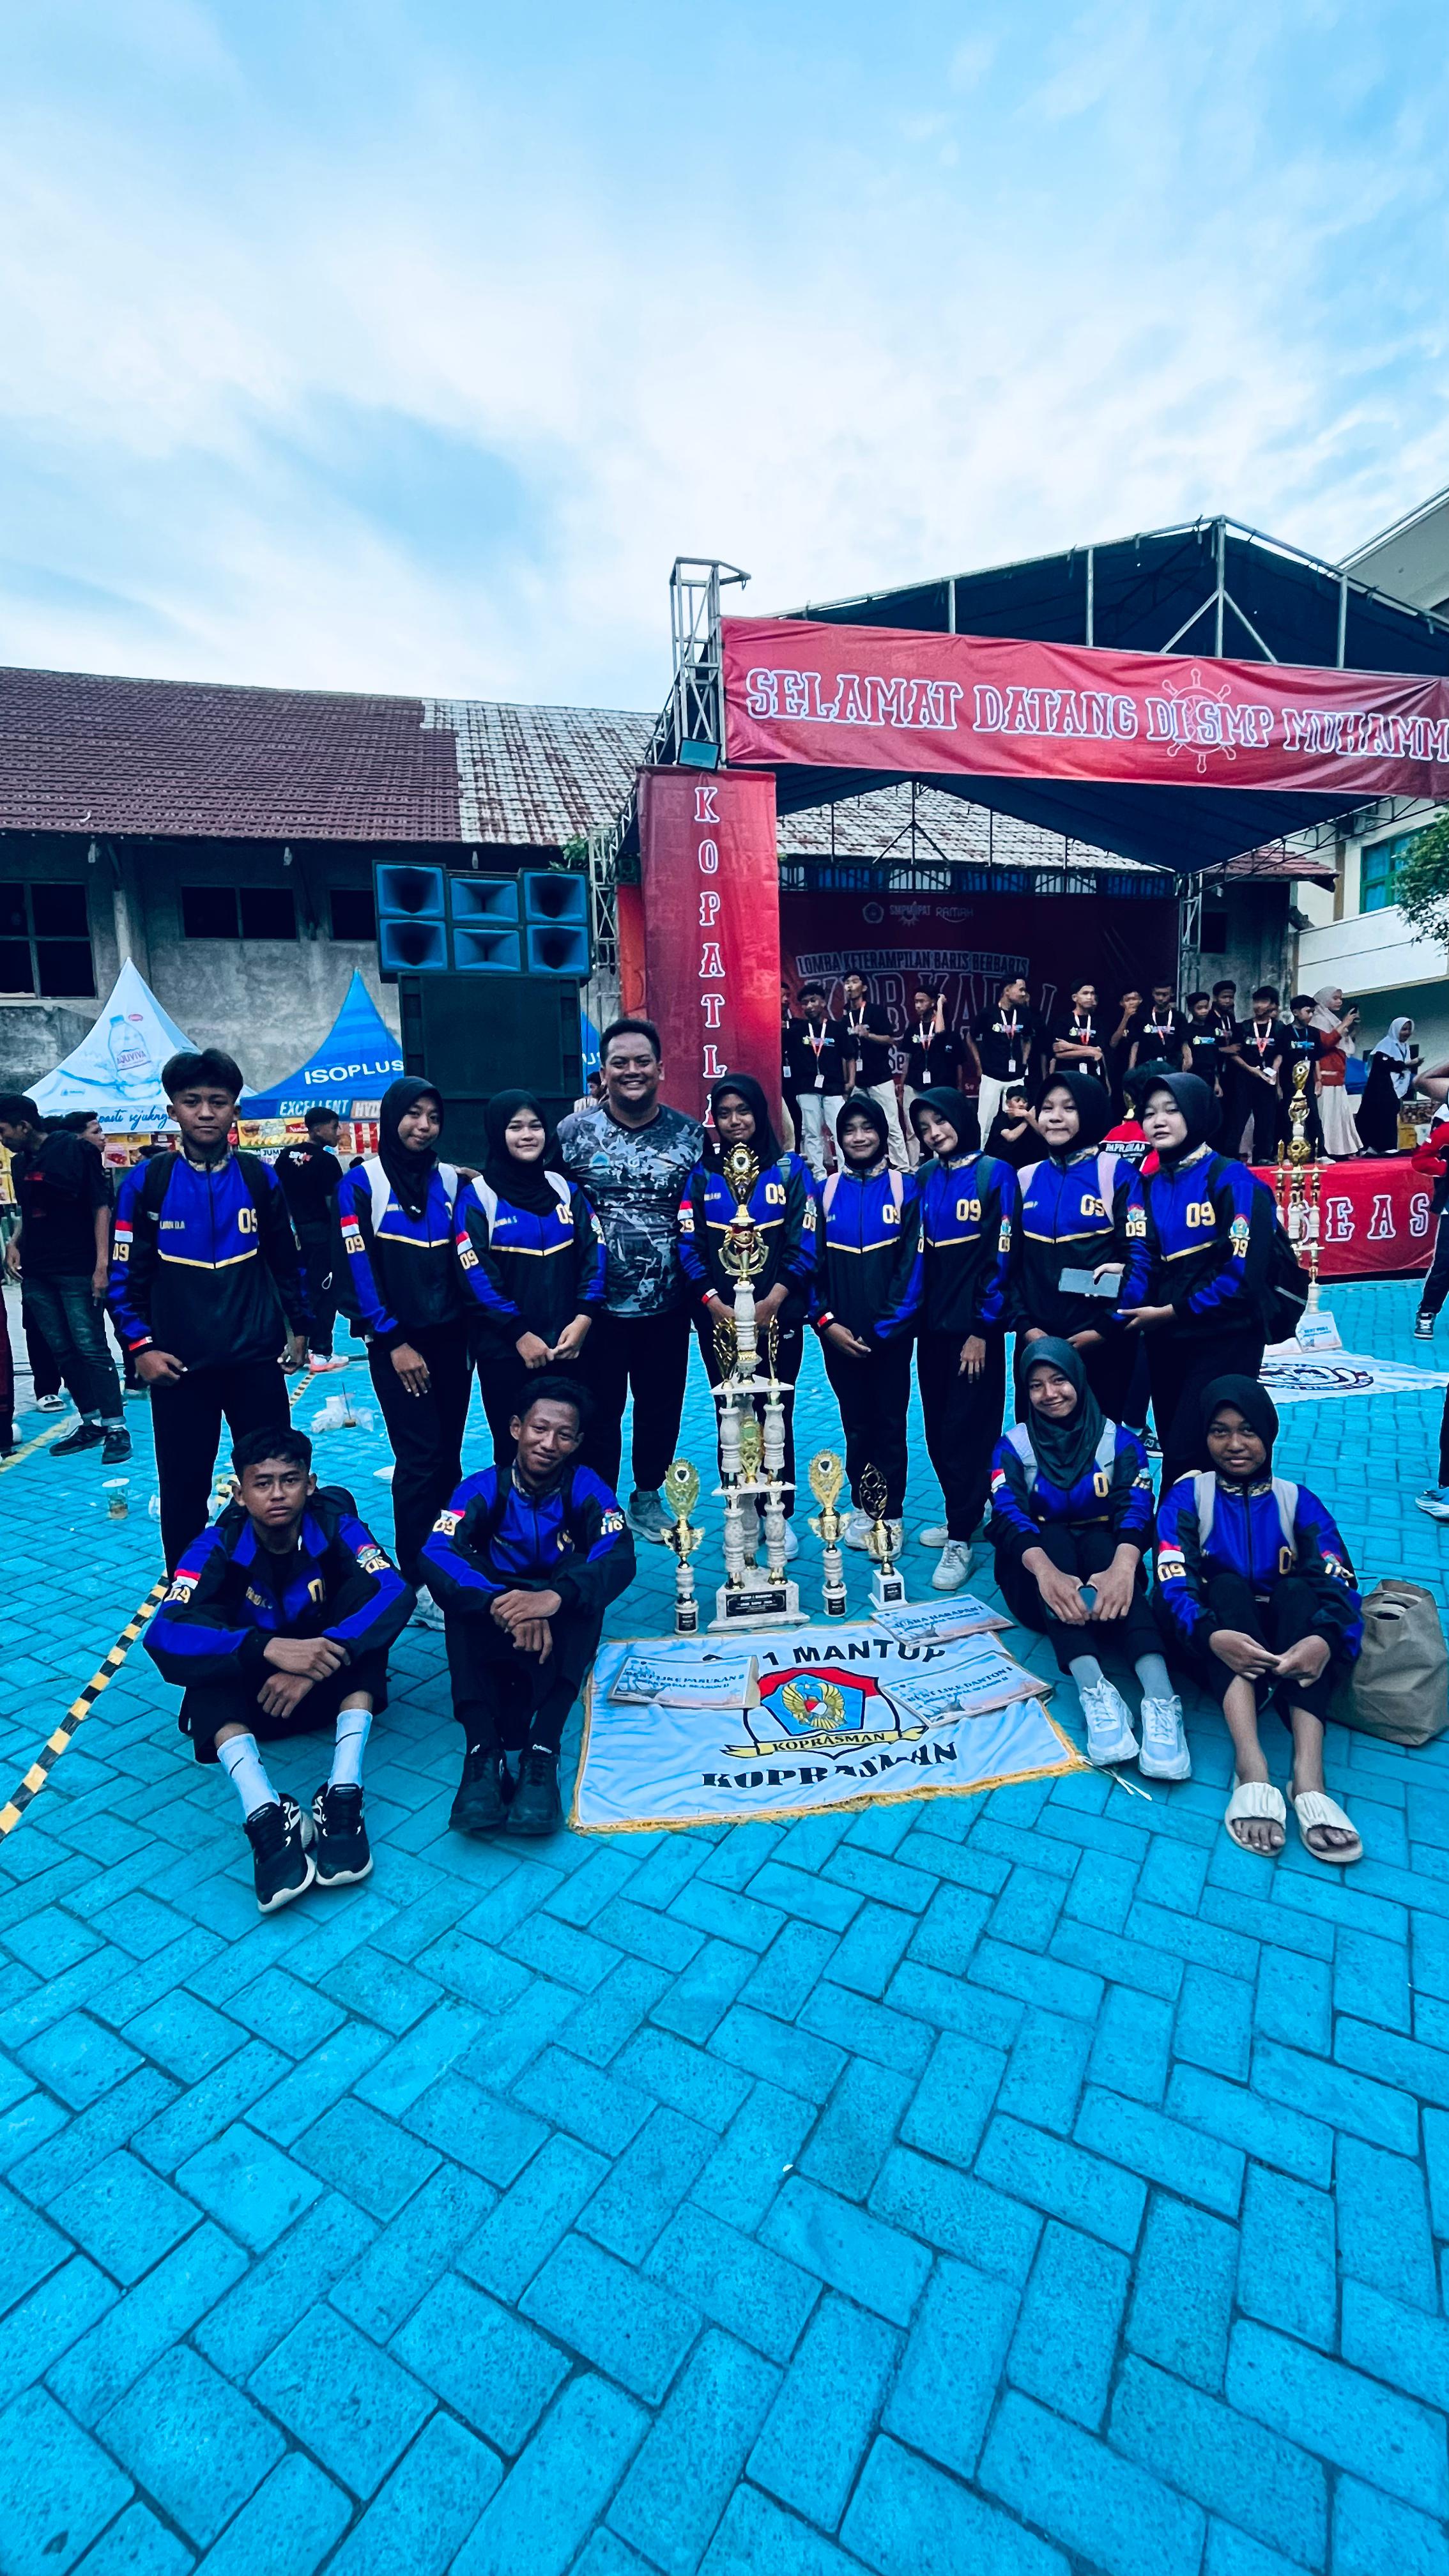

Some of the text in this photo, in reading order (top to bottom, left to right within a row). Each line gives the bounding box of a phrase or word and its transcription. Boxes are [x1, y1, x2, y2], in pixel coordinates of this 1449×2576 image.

[746, 668, 1449, 763] SELAMAT DATANG DI SMP MUHAMM
[797, 953, 841, 976] LOMBA
[842, 950, 931, 970] KETERAMPILAN
[933, 951, 970, 971] BARIS
[304, 1060, 404, 1084] ISOPLUS
[956, 1199, 981, 1221] 09
[1186, 1202, 1216, 1227] 09
[1126, 1221, 1146, 1237] 09
[346, 1235, 365, 1254] 09
[459, 1249, 479, 1270] 09
[1157, 1563, 1186, 1581] 09
[762, 1652, 779, 1666] 1
[963, 1669, 1007, 1688] DANTON
[772, 1732, 885, 1752] KOPRASMAN
